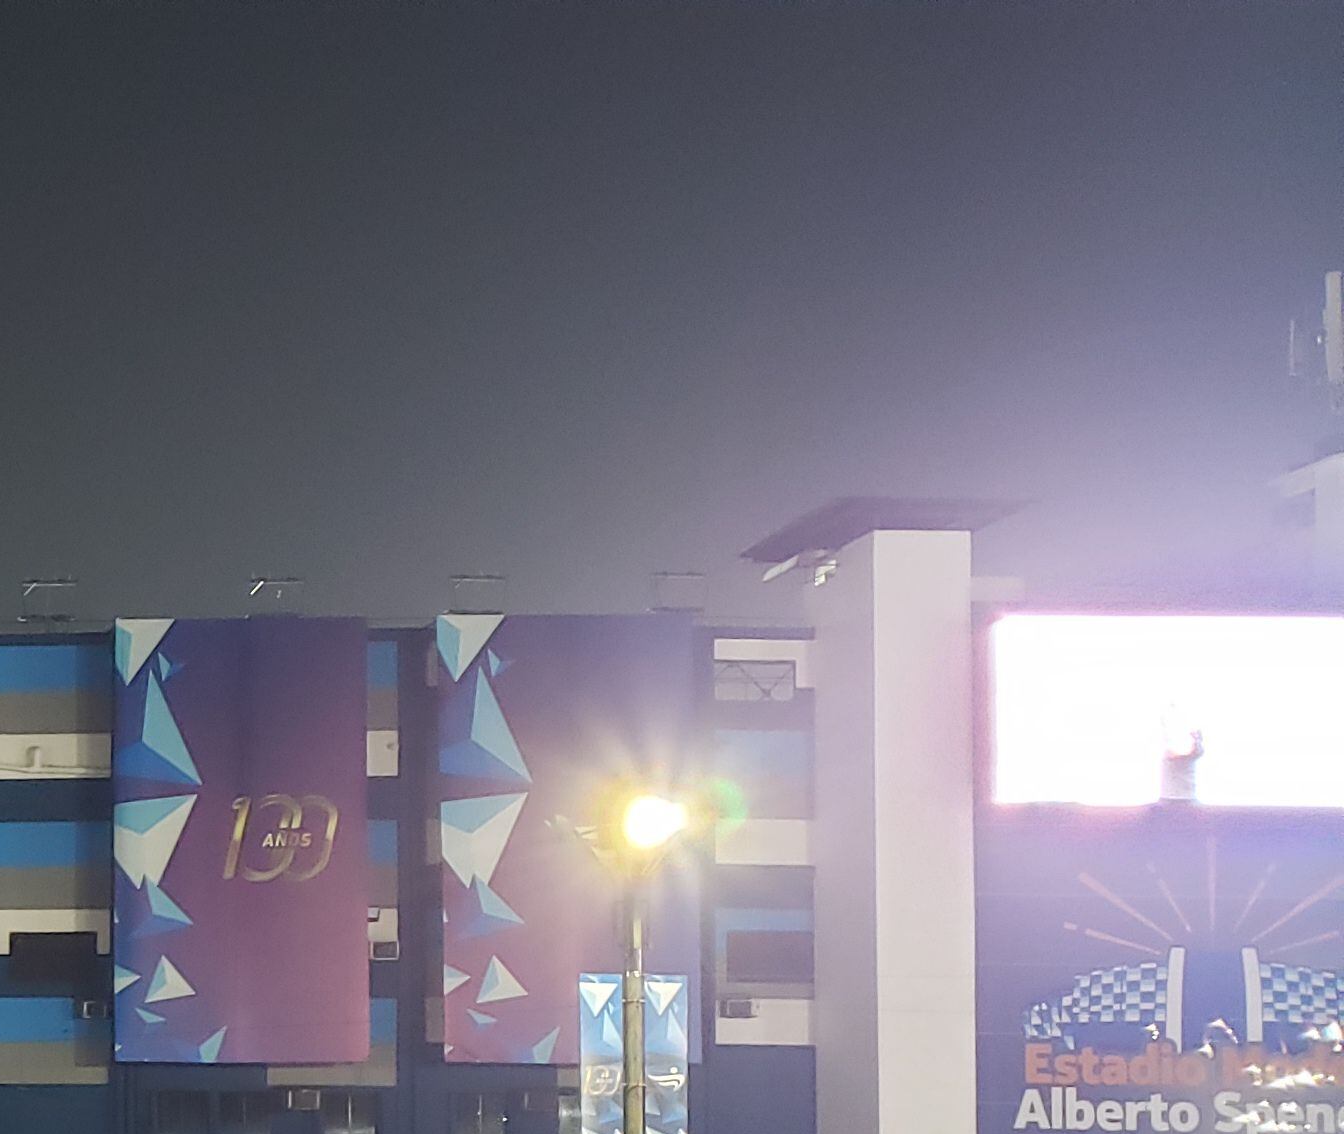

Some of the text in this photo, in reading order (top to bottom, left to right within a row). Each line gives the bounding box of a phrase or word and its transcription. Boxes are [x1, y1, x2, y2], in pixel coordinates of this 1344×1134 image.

[222, 794, 339, 881] 100
[1025, 1038, 1207, 1086] Estadio
[1013, 1086, 1200, 1132] Alberto
